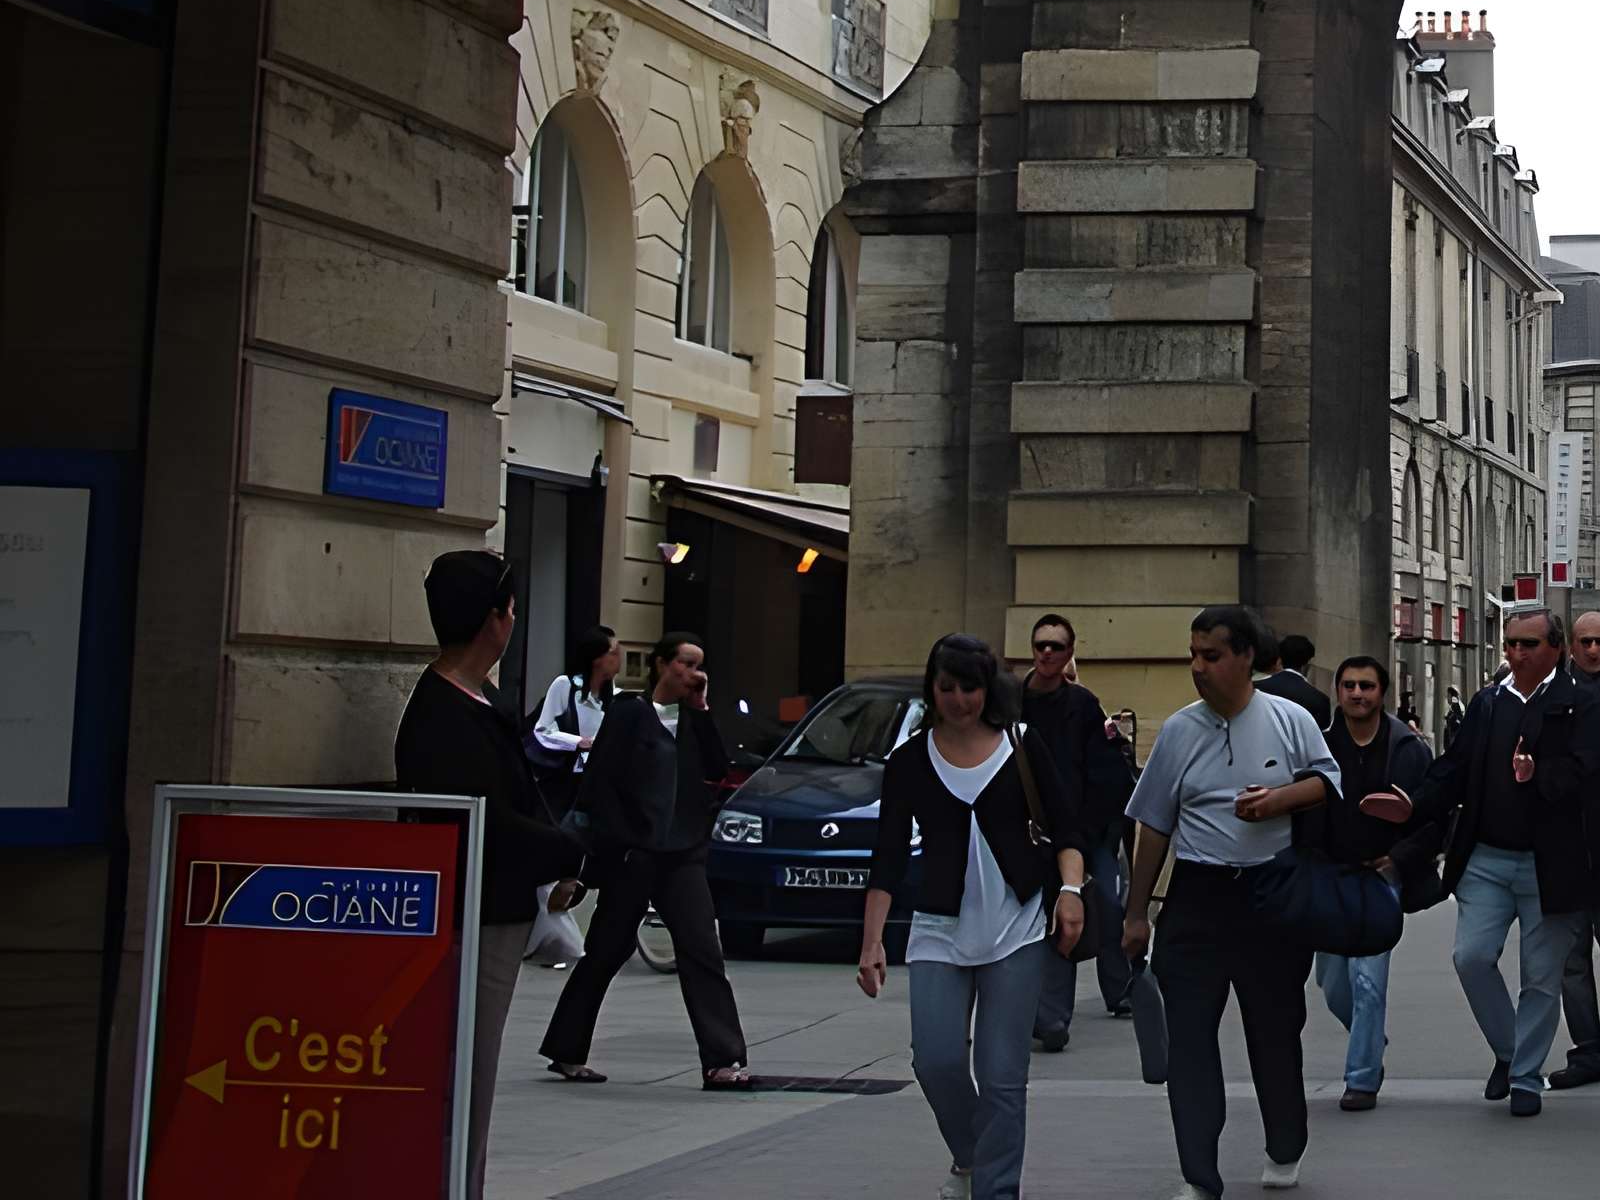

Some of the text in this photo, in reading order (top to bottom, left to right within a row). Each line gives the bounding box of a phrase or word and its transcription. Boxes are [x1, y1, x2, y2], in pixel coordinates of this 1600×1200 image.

[271, 891, 421, 928] OCIANE
[244, 1015, 389, 1076] C'est
[279, 1093, 343, 1152] ici
